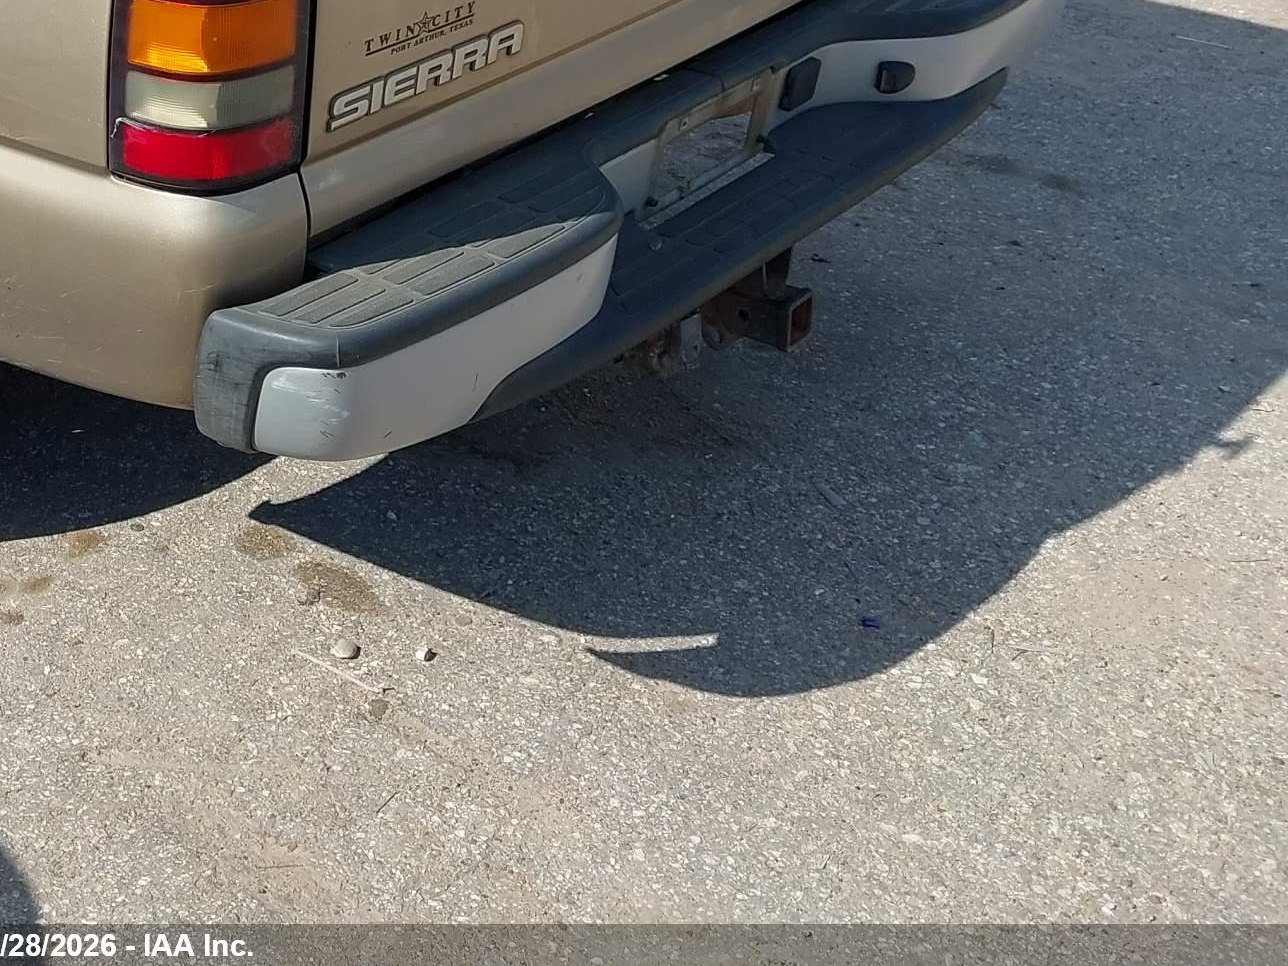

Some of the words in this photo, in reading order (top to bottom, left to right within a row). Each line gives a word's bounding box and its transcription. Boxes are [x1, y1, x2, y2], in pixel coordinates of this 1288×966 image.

[365, 22, 418, 52] TWIN
[431, 0, 476, 28] CITY
[391, 42, 412, 55] PORT
[450, 18, 473, 33] TEXAS
[325, 19, 525, 133] SIERRA
